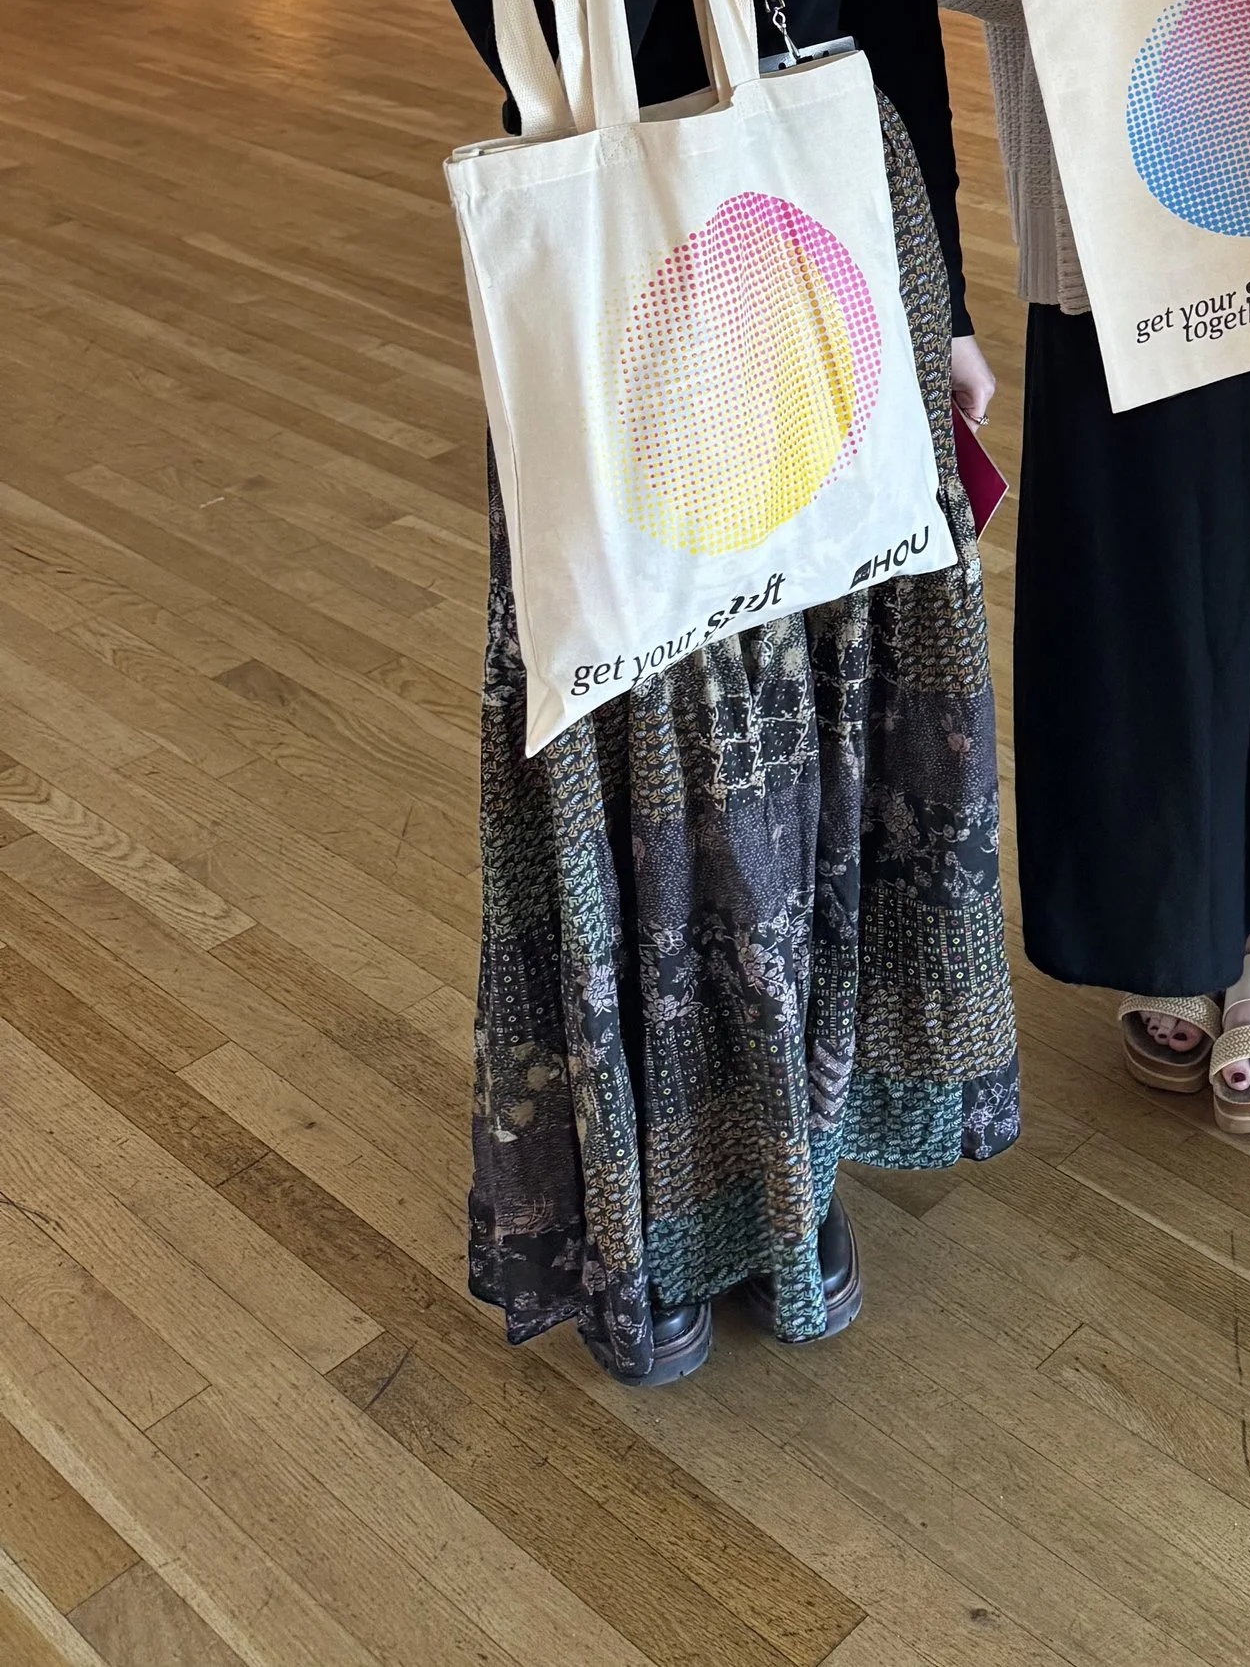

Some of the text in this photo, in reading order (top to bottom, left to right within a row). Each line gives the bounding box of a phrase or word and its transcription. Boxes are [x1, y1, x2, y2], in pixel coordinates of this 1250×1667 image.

[1136, 307, 1174, 343] get
[1179, 290, 1236, 329] your
[872, 525, 929, 578] HOU
[570, 654, 625, 696] get
[632, 627, 697, 681] your
